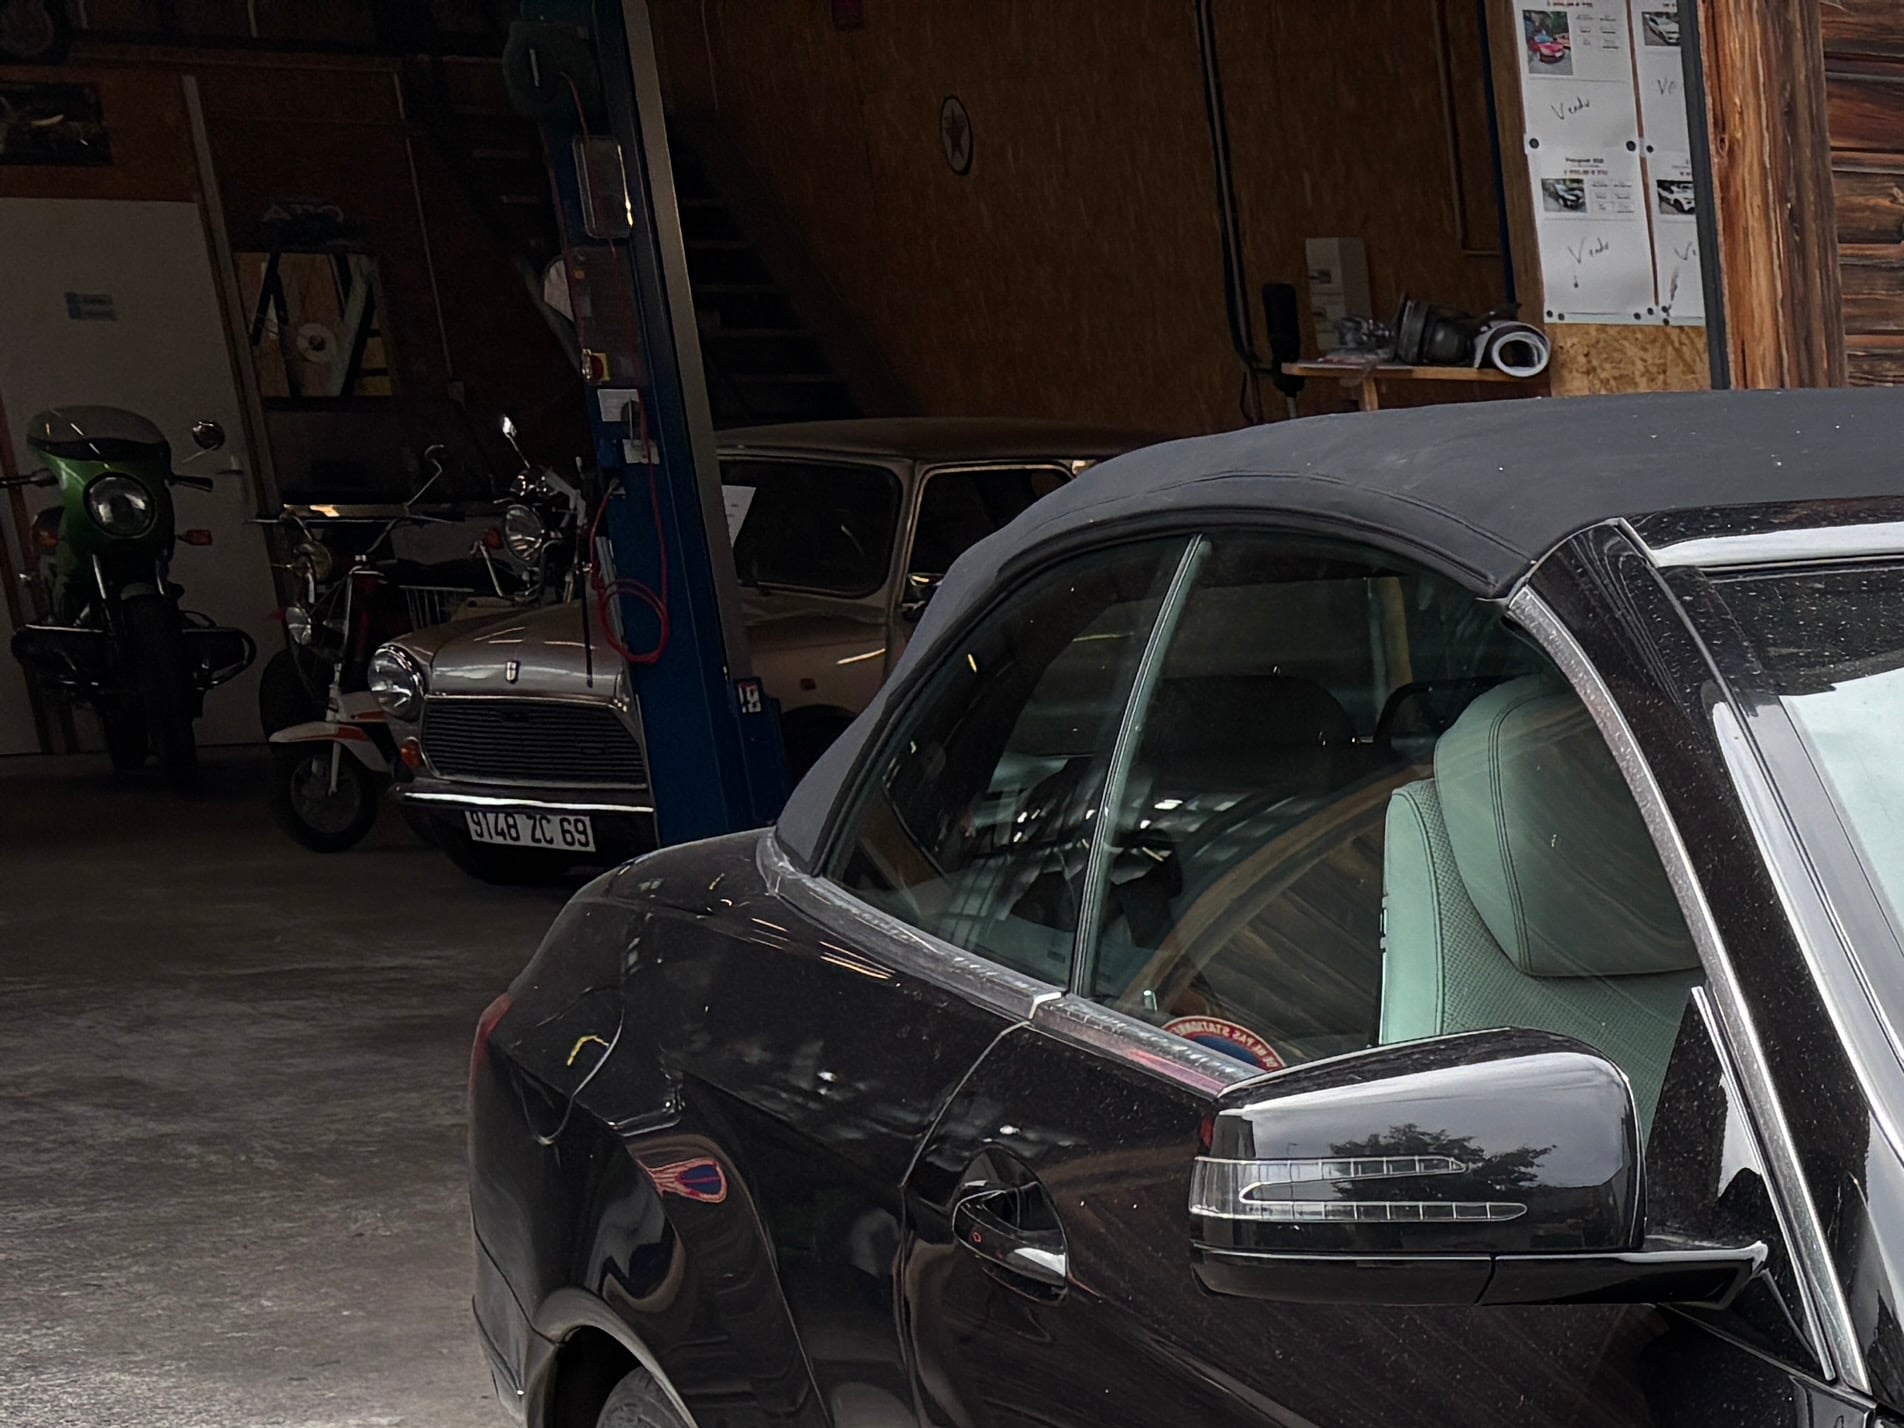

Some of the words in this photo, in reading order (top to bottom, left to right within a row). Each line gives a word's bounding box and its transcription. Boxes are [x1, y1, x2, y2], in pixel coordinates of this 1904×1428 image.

[470, 810, 520, 842] 9148
[525, 814, 555, 846] ZC
[559, 816, 590, 848] 69
